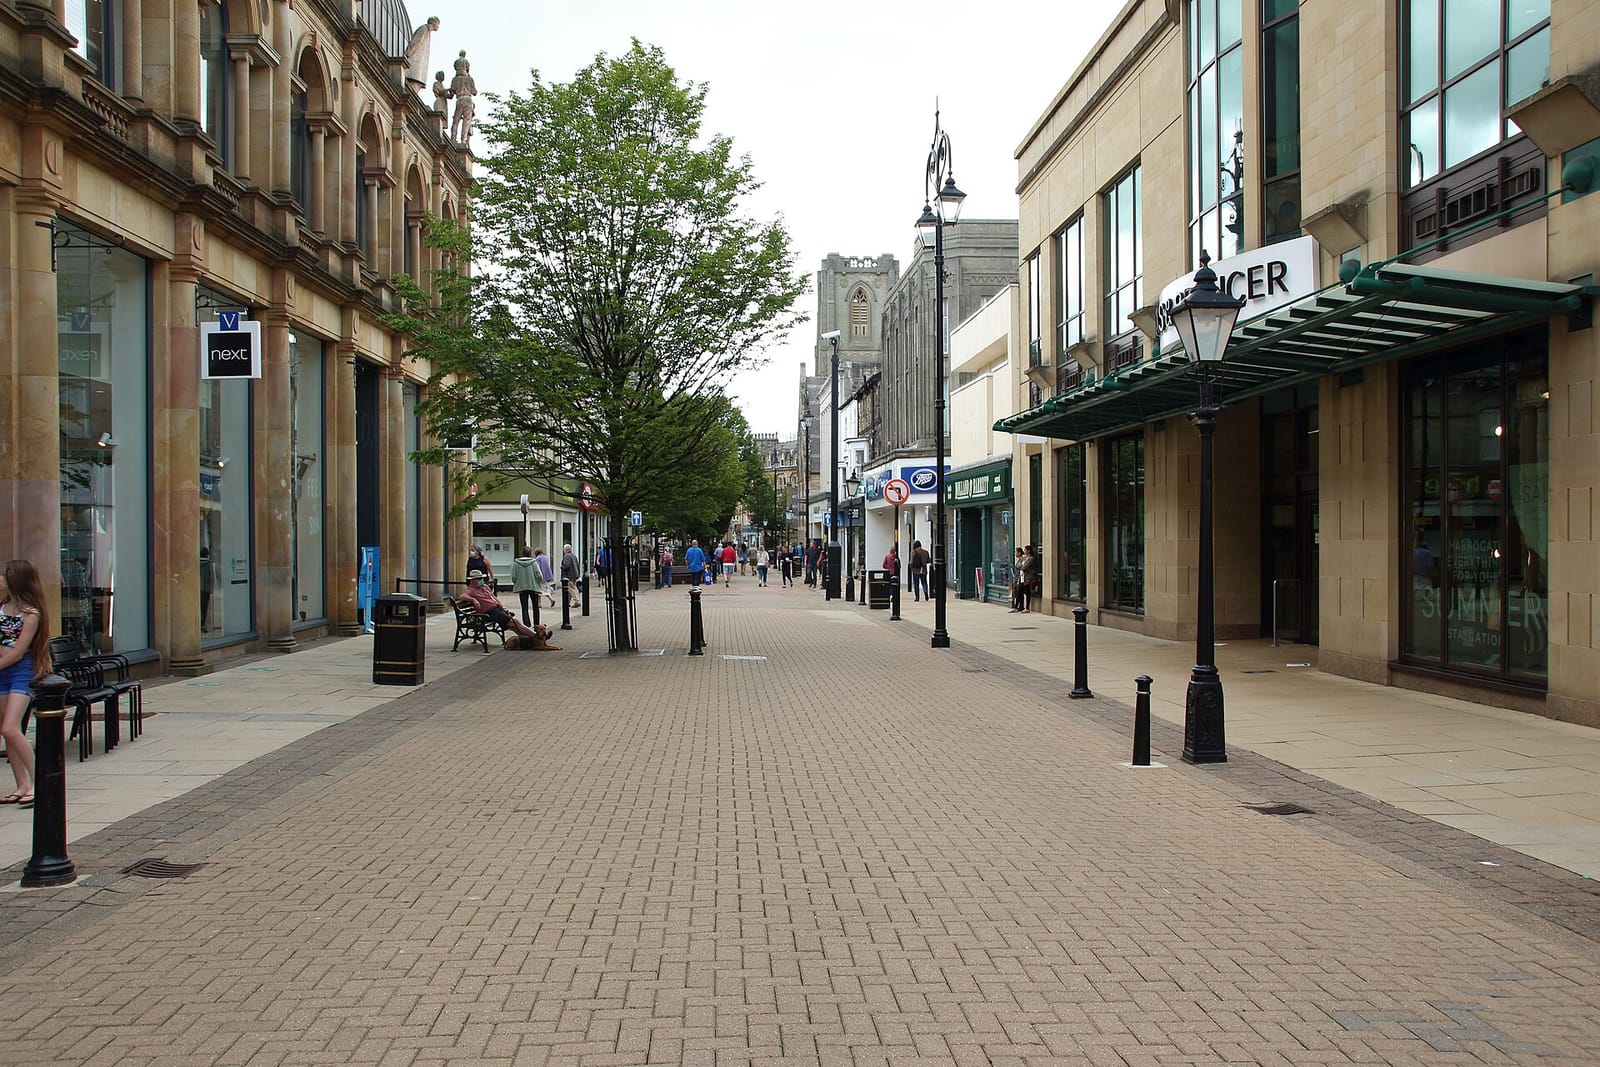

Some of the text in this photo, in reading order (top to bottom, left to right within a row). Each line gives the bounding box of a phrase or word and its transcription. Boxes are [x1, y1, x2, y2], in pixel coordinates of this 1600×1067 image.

[221, 313, 236, 329] V
[211, 348, 248, 361] next
[1523, 484, 1548, 503] SAL
[1448, 556, 1501, 569] EVERYTHIN
[1422, 585, 1542, 629] SUMMER
